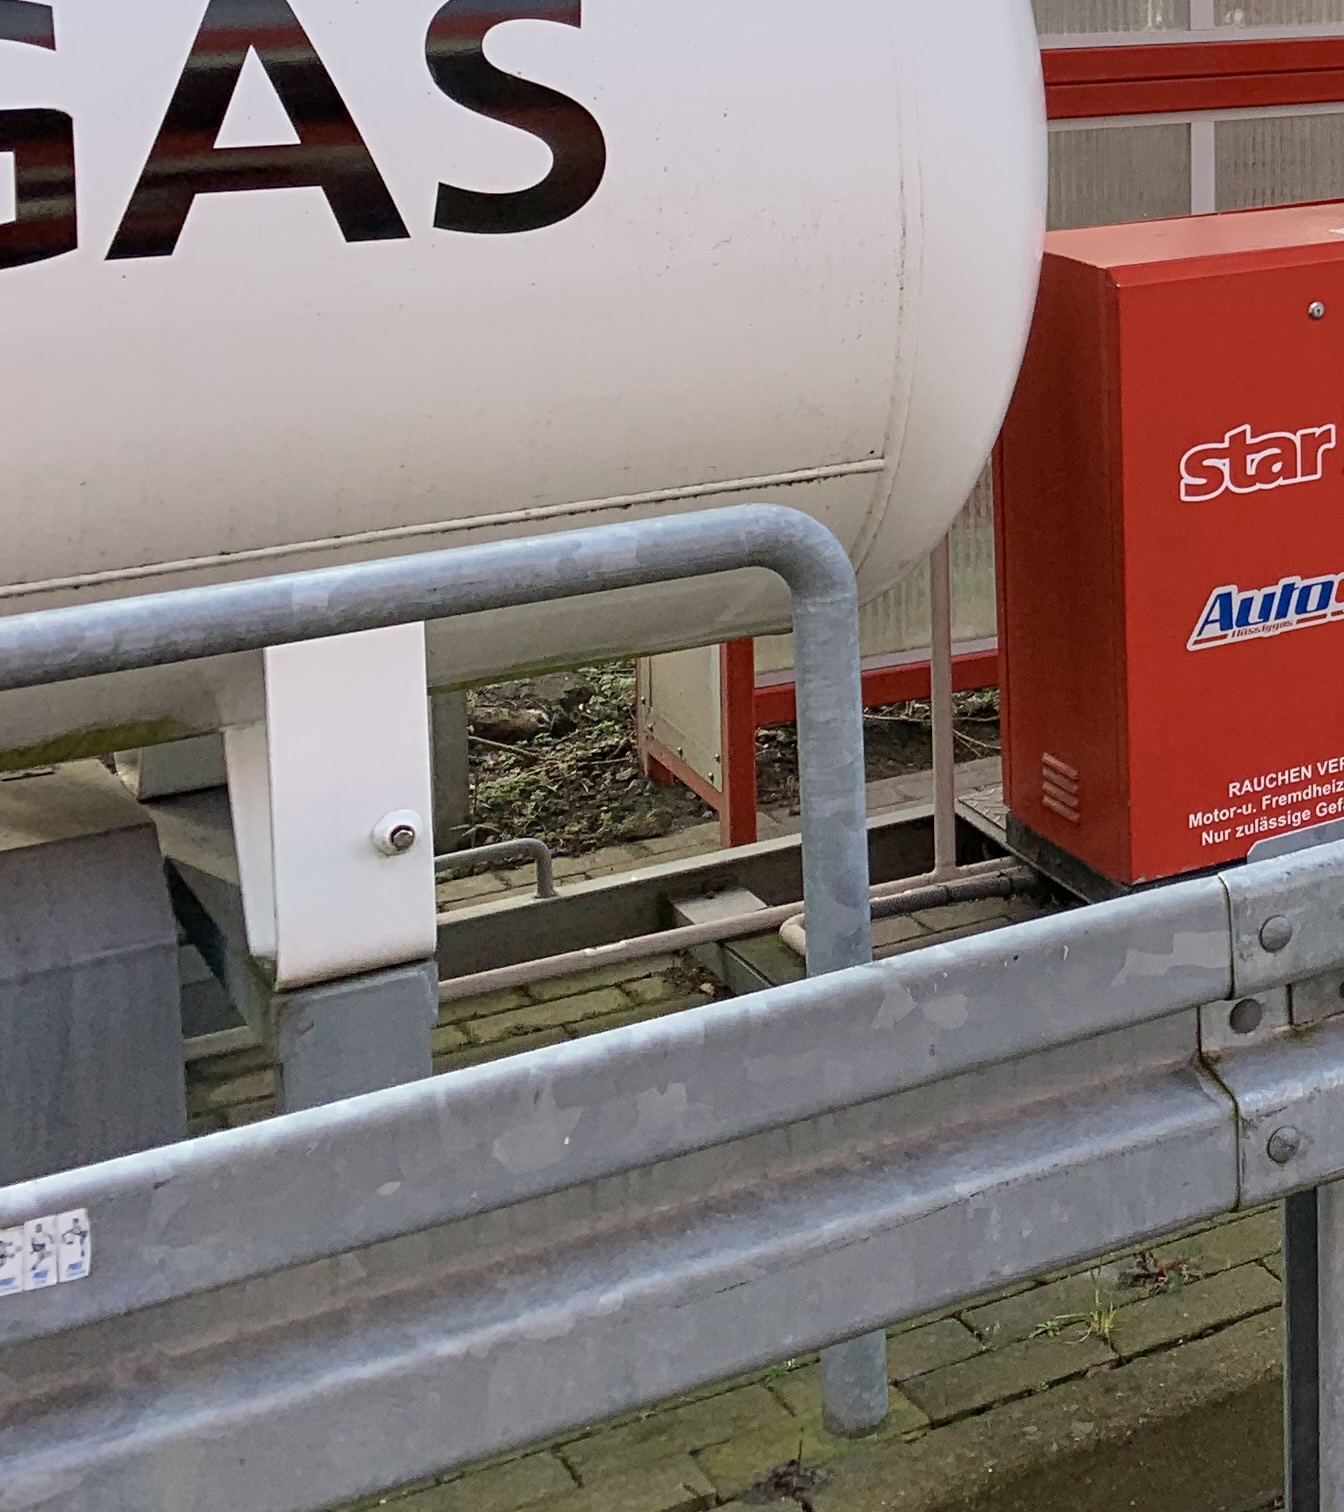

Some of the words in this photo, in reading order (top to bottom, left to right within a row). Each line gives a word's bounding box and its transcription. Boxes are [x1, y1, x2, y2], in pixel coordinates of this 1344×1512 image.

[1180, 424, 1337, 502] star
[1228, 764, 1313, 798] RAUCHEN
[1188, 799, 1257, 829] Motor-u.
[1201, 827, 1232, 846] Nur
[1235, 808, 1311, 839] zulässige
